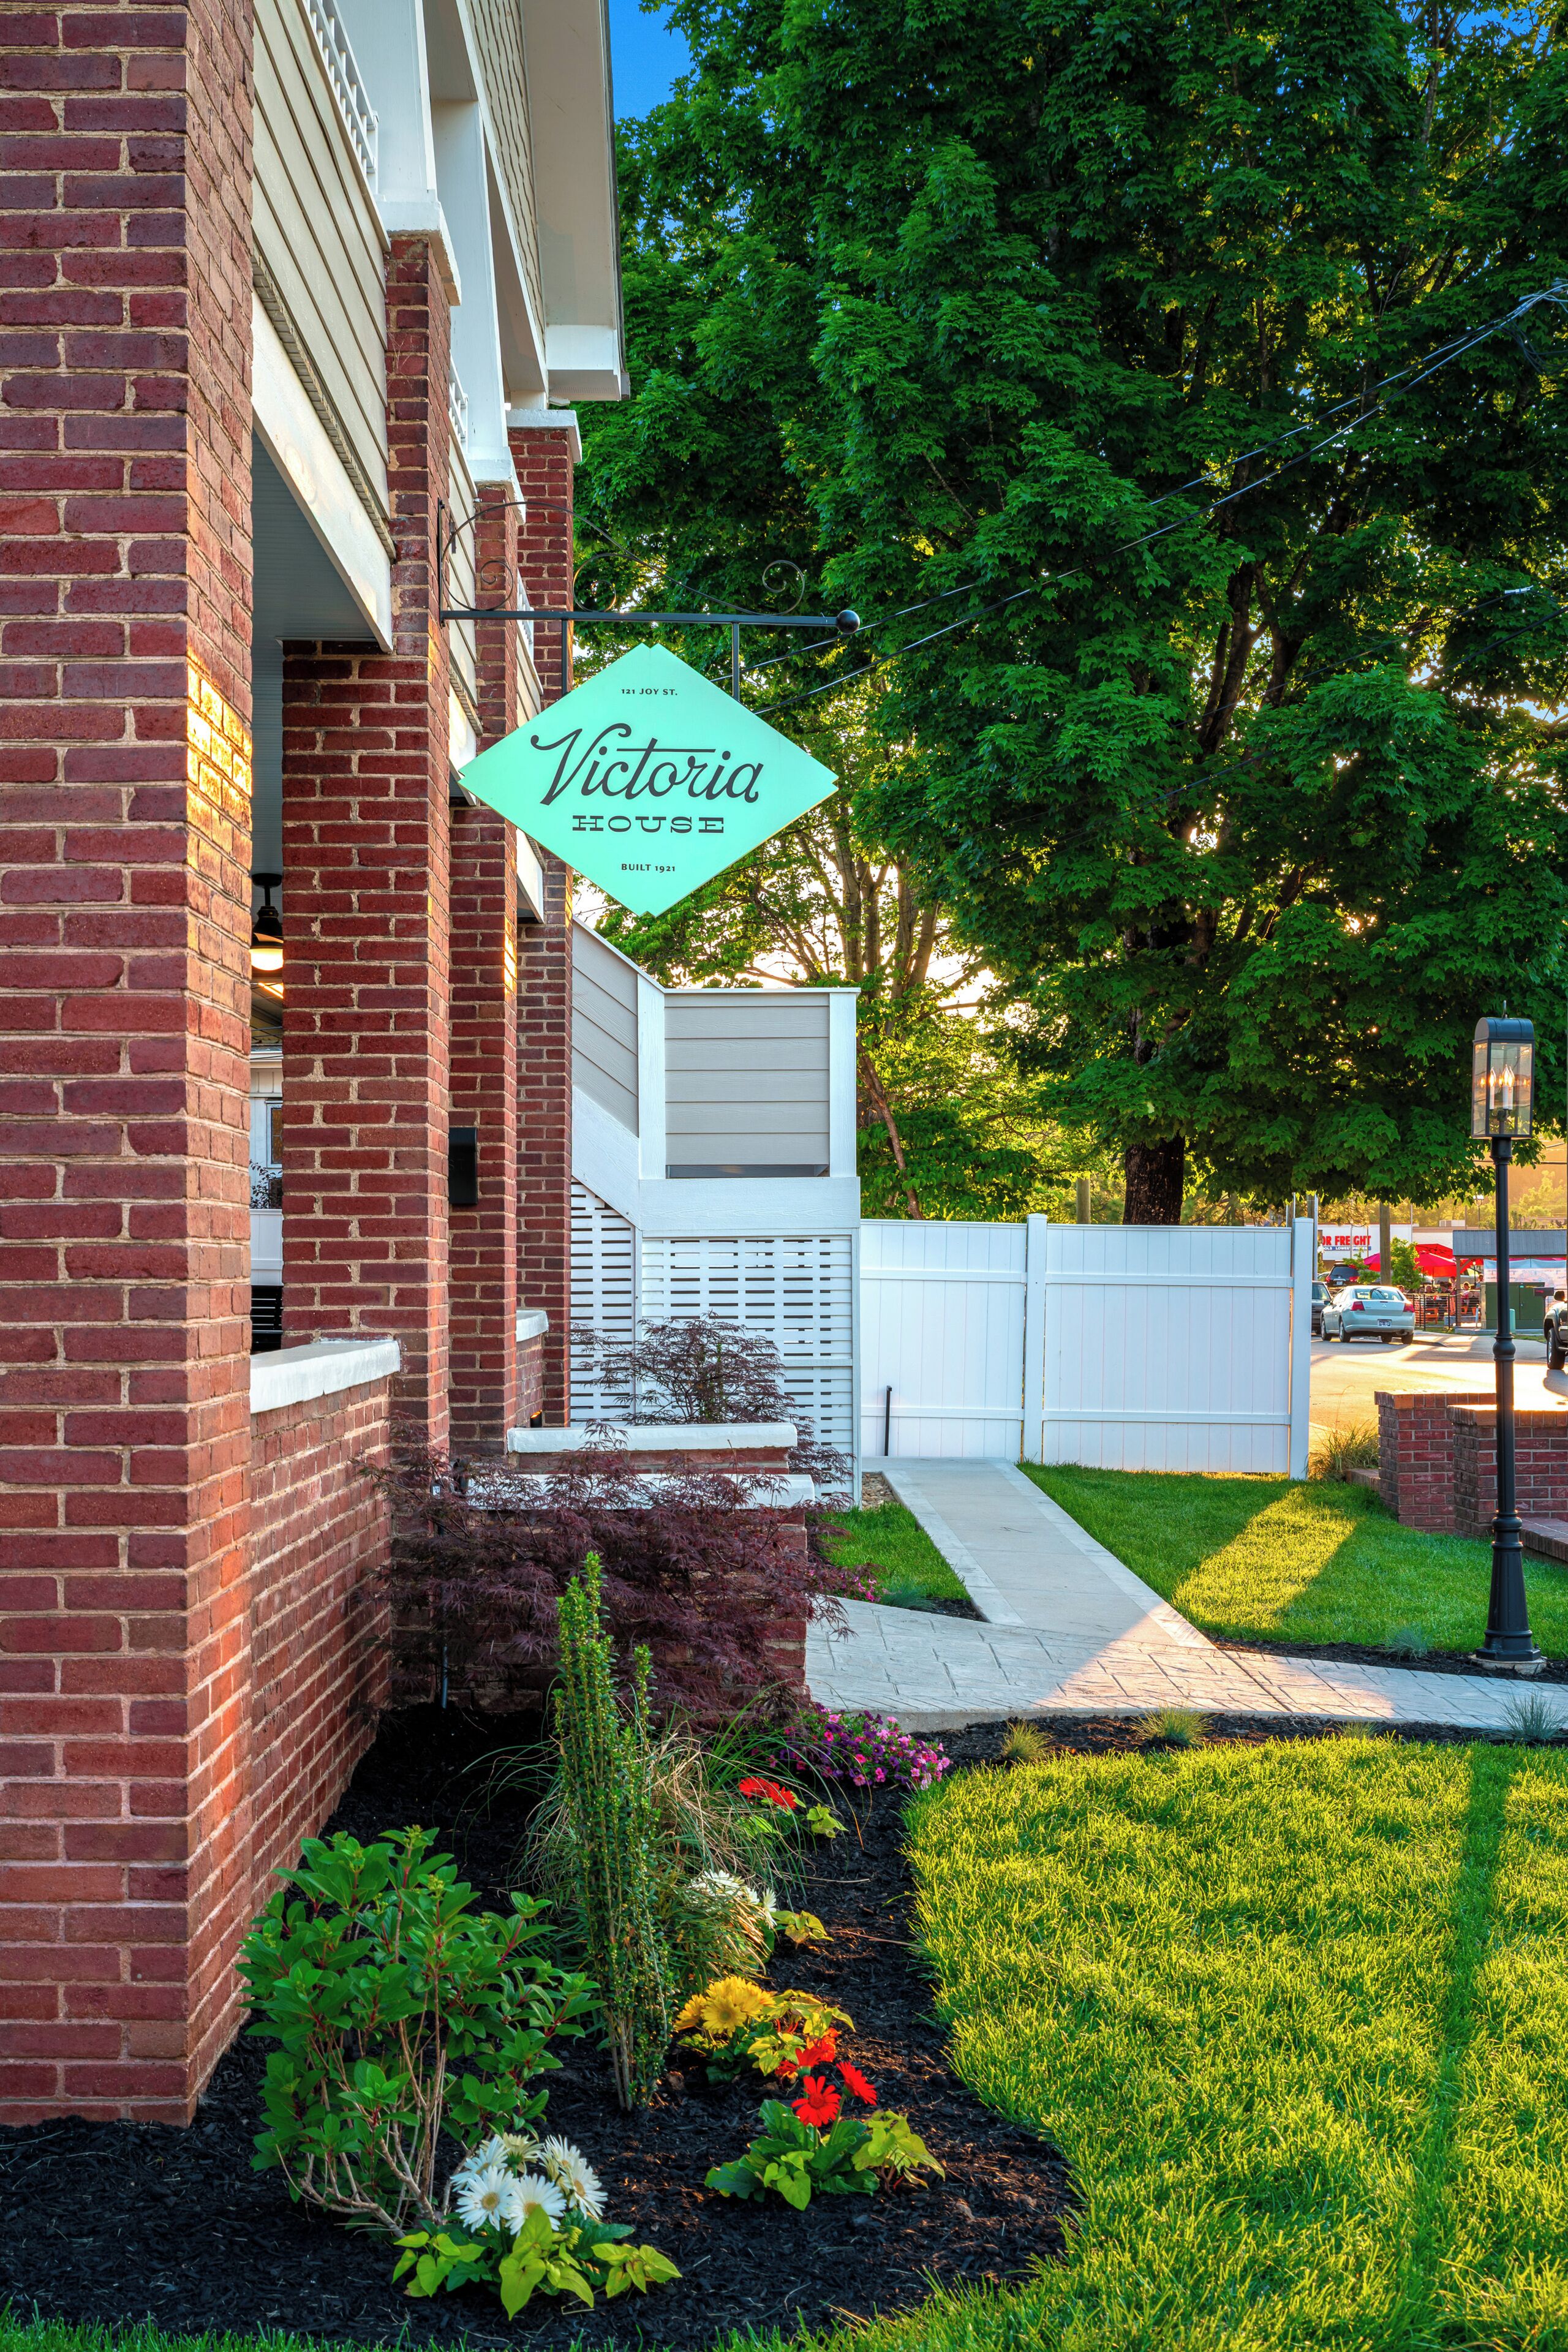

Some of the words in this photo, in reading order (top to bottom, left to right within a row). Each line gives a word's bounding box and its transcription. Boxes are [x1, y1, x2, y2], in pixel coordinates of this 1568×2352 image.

[530, 723, 764, 805] Victoria
[572, 815, 724, 834] HOUSE
[621, 863, 652, 872] BUILT
[655, 865, 676, 873] 1921
